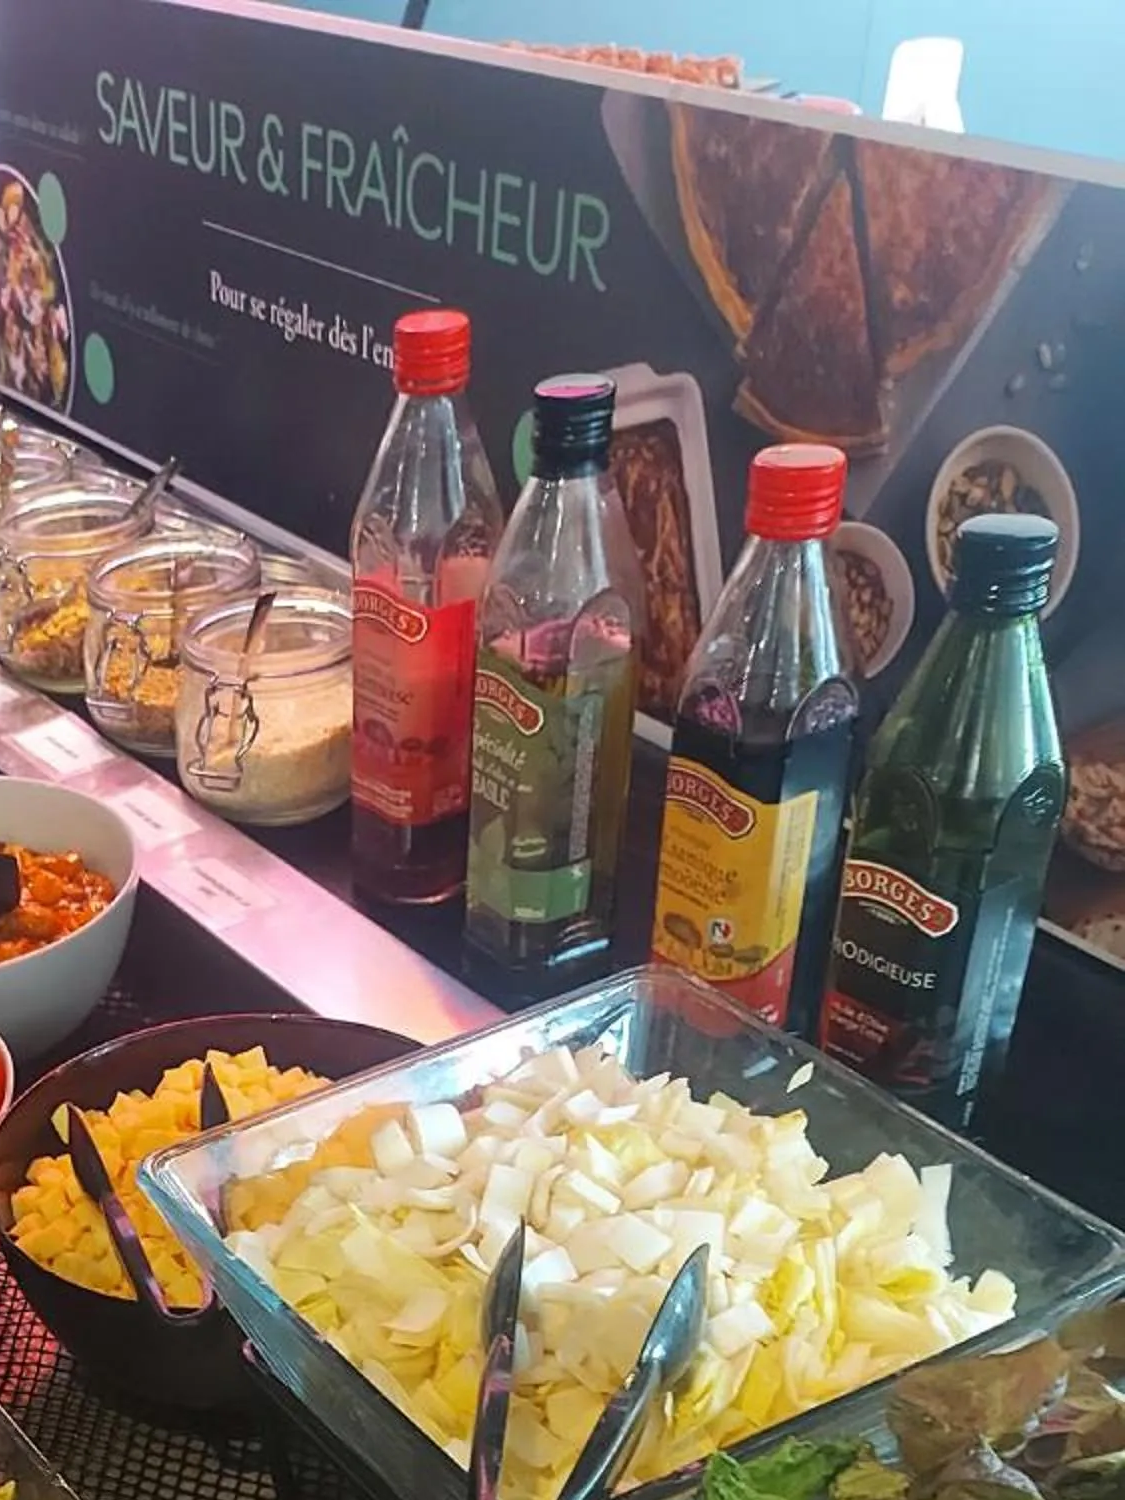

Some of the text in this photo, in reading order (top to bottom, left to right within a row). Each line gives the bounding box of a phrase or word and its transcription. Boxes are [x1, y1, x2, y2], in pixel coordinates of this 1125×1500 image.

[95, 70, 610, 293] SAVEUR & FRAÎCHEUR
[209, 270, 247, 313] Pour
[249, 296, 267, 321] se
[270, 296, 325, 342] régaler
[328, 314, 358, 355] dès
[362, 324, 394, 370] l'en
[475, 676, 526, 720] ORGES
[843, 868, 936, 922] BORGES
[833, 936, 937, 989] RODIGIEUSE
